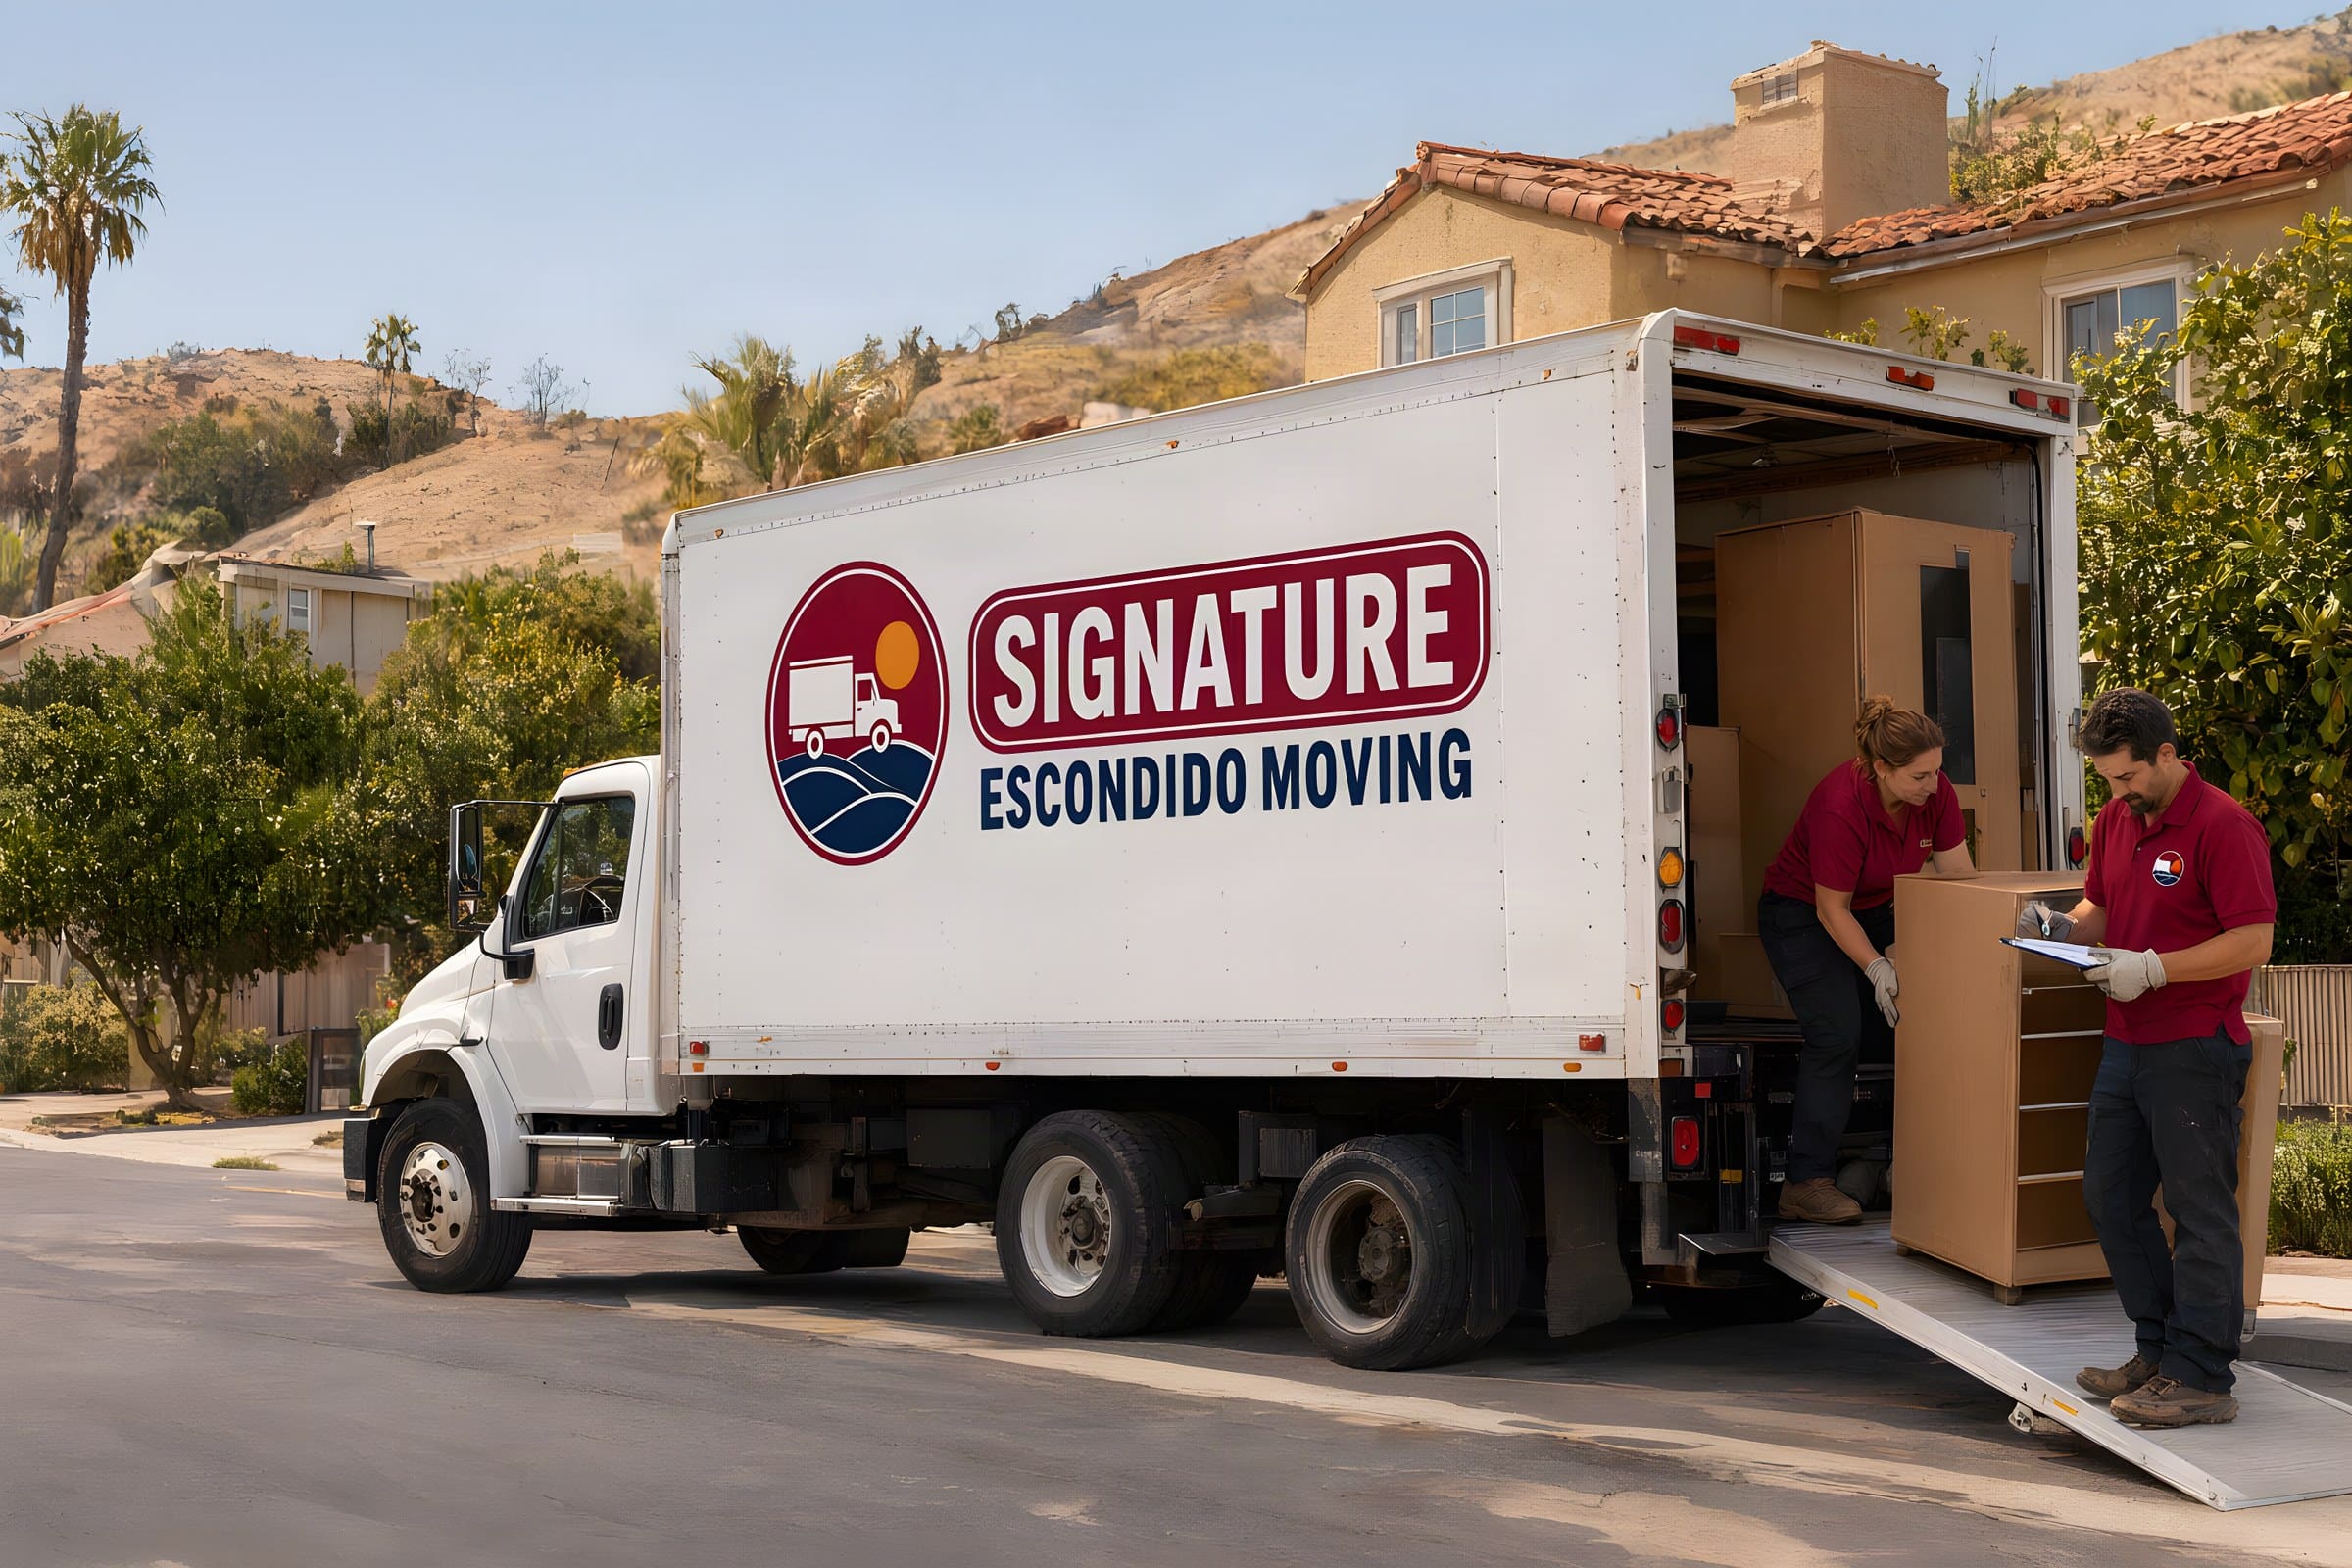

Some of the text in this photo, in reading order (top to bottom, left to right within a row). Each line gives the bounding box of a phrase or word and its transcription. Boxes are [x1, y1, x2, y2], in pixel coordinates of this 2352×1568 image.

[993, 563, 1454, 728] SIGNATURE
[980, 728, 1472, 831] ESCONDIDO MOVING
